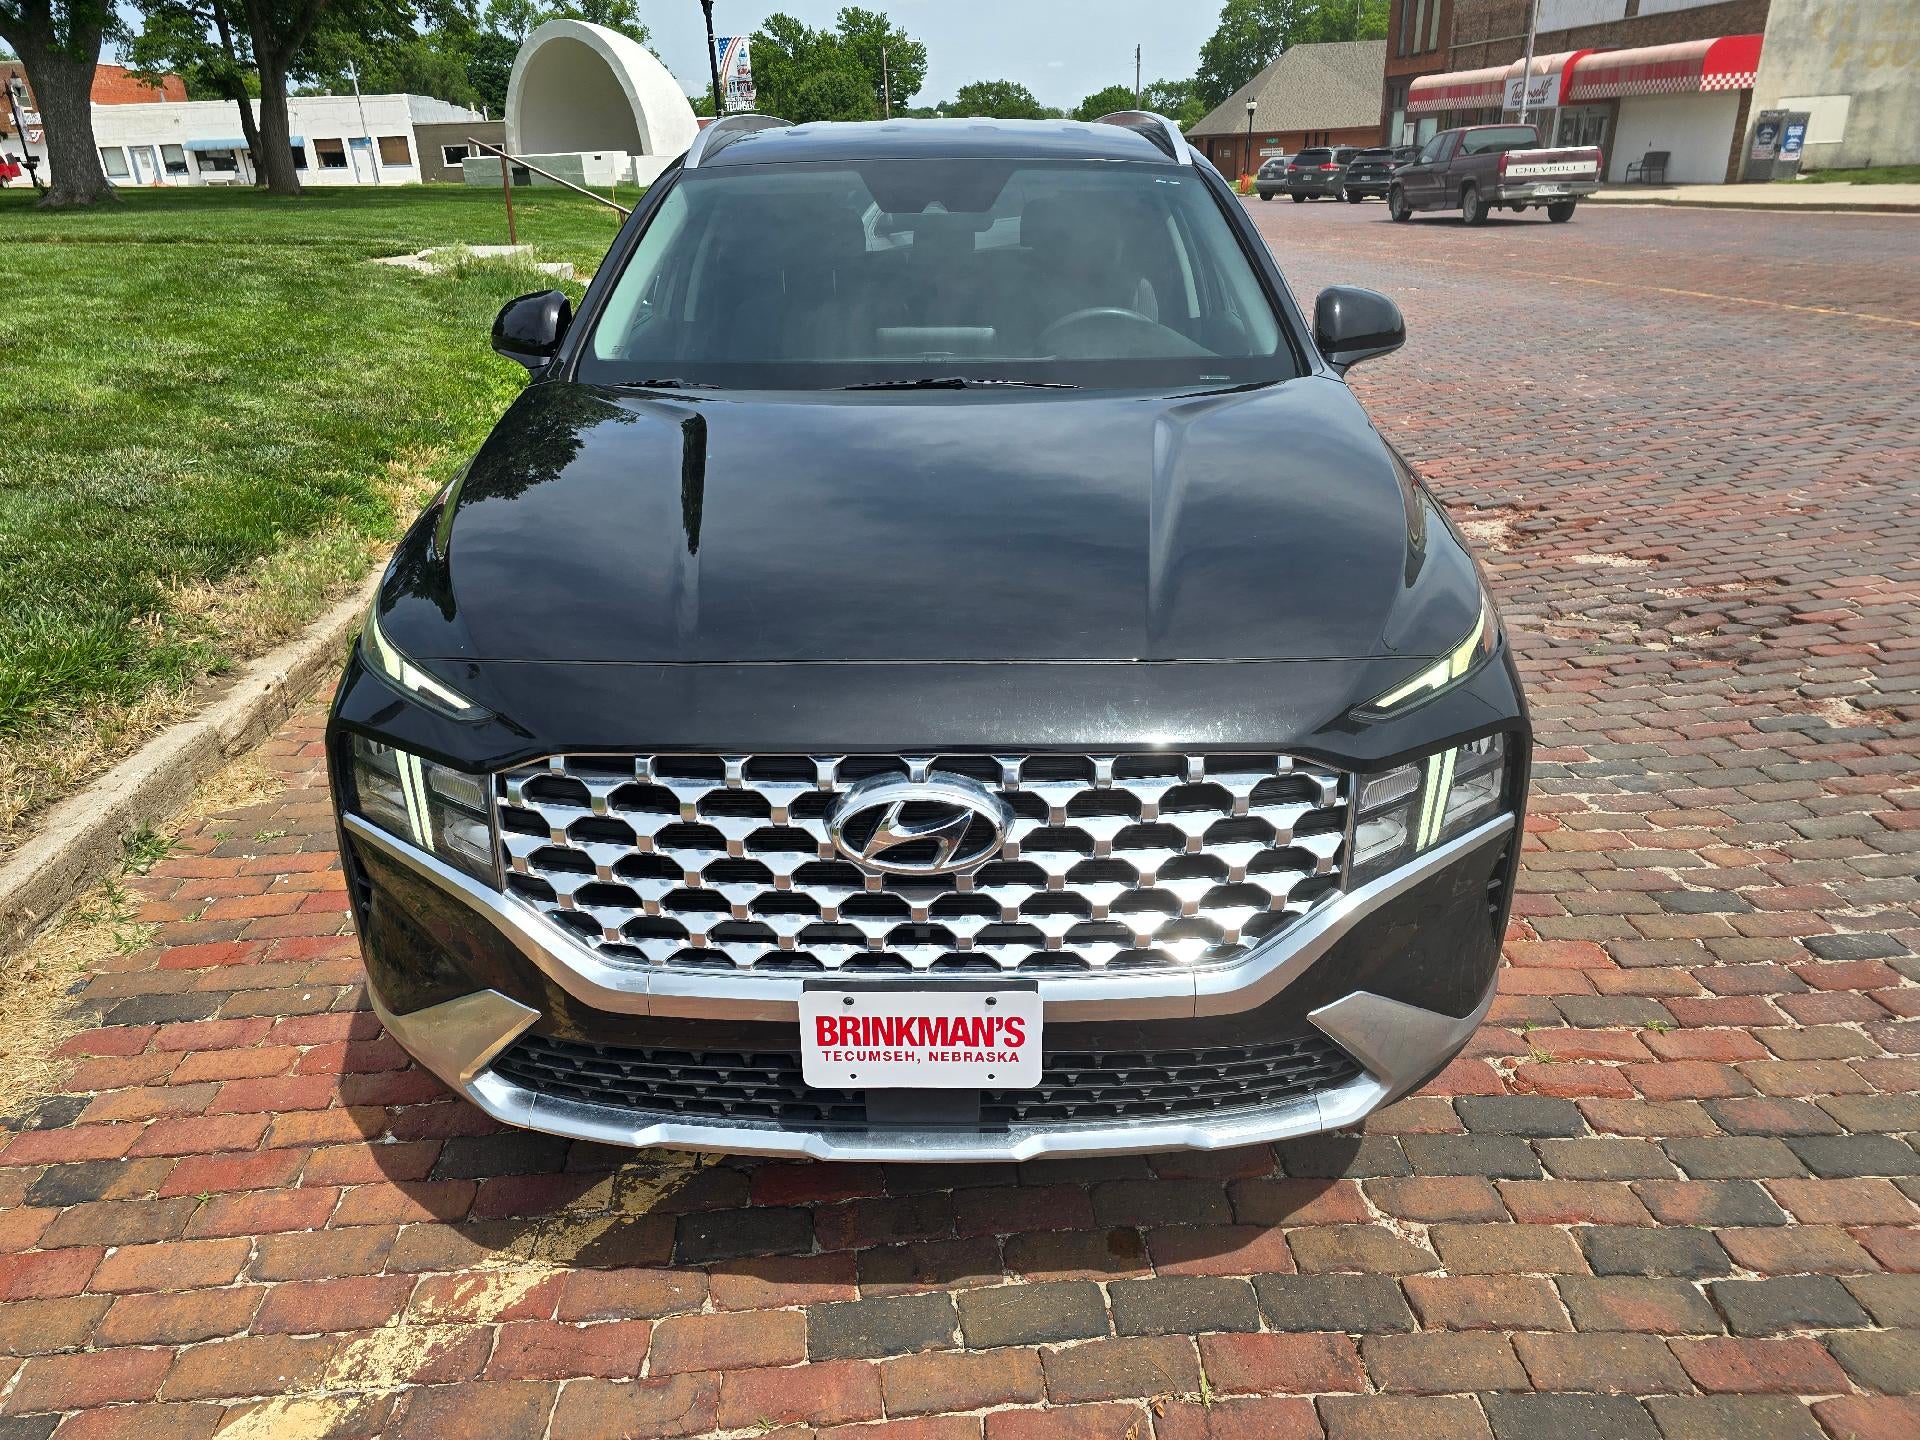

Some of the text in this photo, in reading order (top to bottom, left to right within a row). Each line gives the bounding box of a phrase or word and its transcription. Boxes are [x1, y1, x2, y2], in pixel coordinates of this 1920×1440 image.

[815, 1016, 1025, 1048] BRINKMAN'S
[822, 1050, 1020, 1064] TECUMSEH, NEBRASKA
